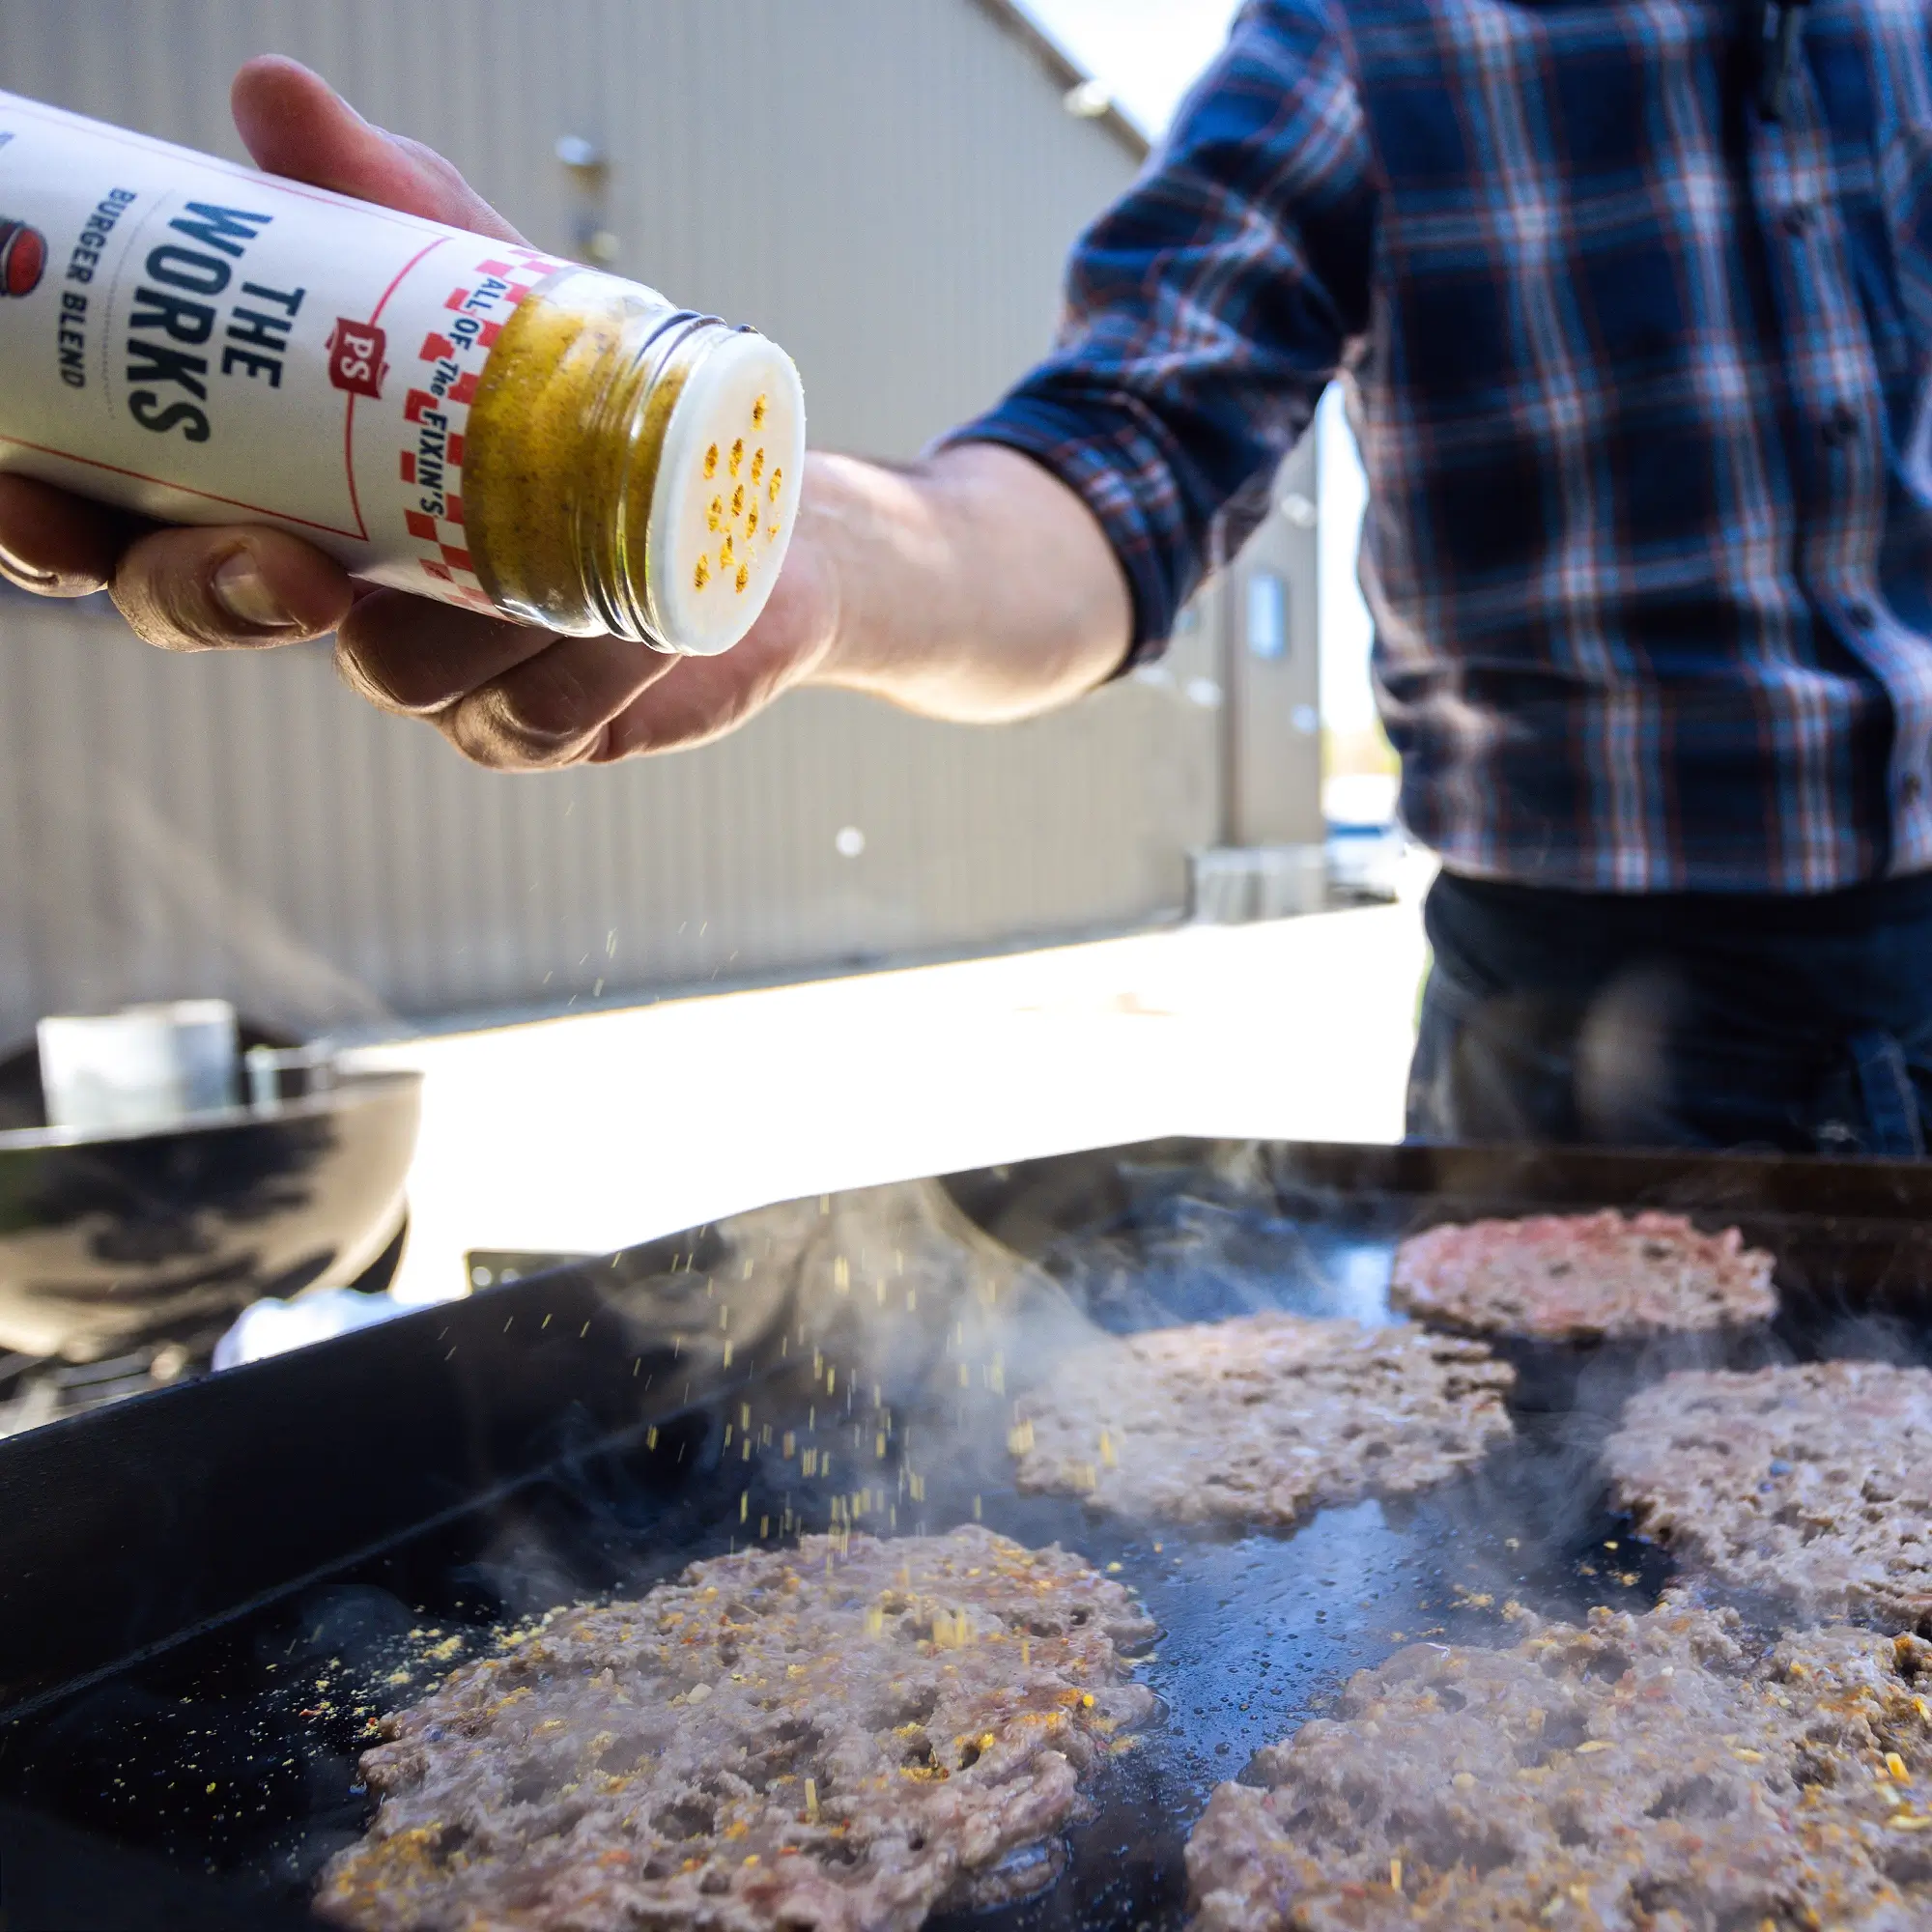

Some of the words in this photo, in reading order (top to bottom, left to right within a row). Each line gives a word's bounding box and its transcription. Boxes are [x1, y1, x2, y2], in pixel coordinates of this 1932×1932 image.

[66, 187, 137, 286] BURGER
[59, 292, 88, 388] BLEND
[127, 201, 273, 443] WORKS
[220, 280, 306, 388] THE
[449, 318, 479, 353] OF
[462, 276, 508, 311] ALL
[340, 333, 375, 383] PS
[430, 359, 459, 396] The
[417, 409, 447, 518] FIXIN'S
